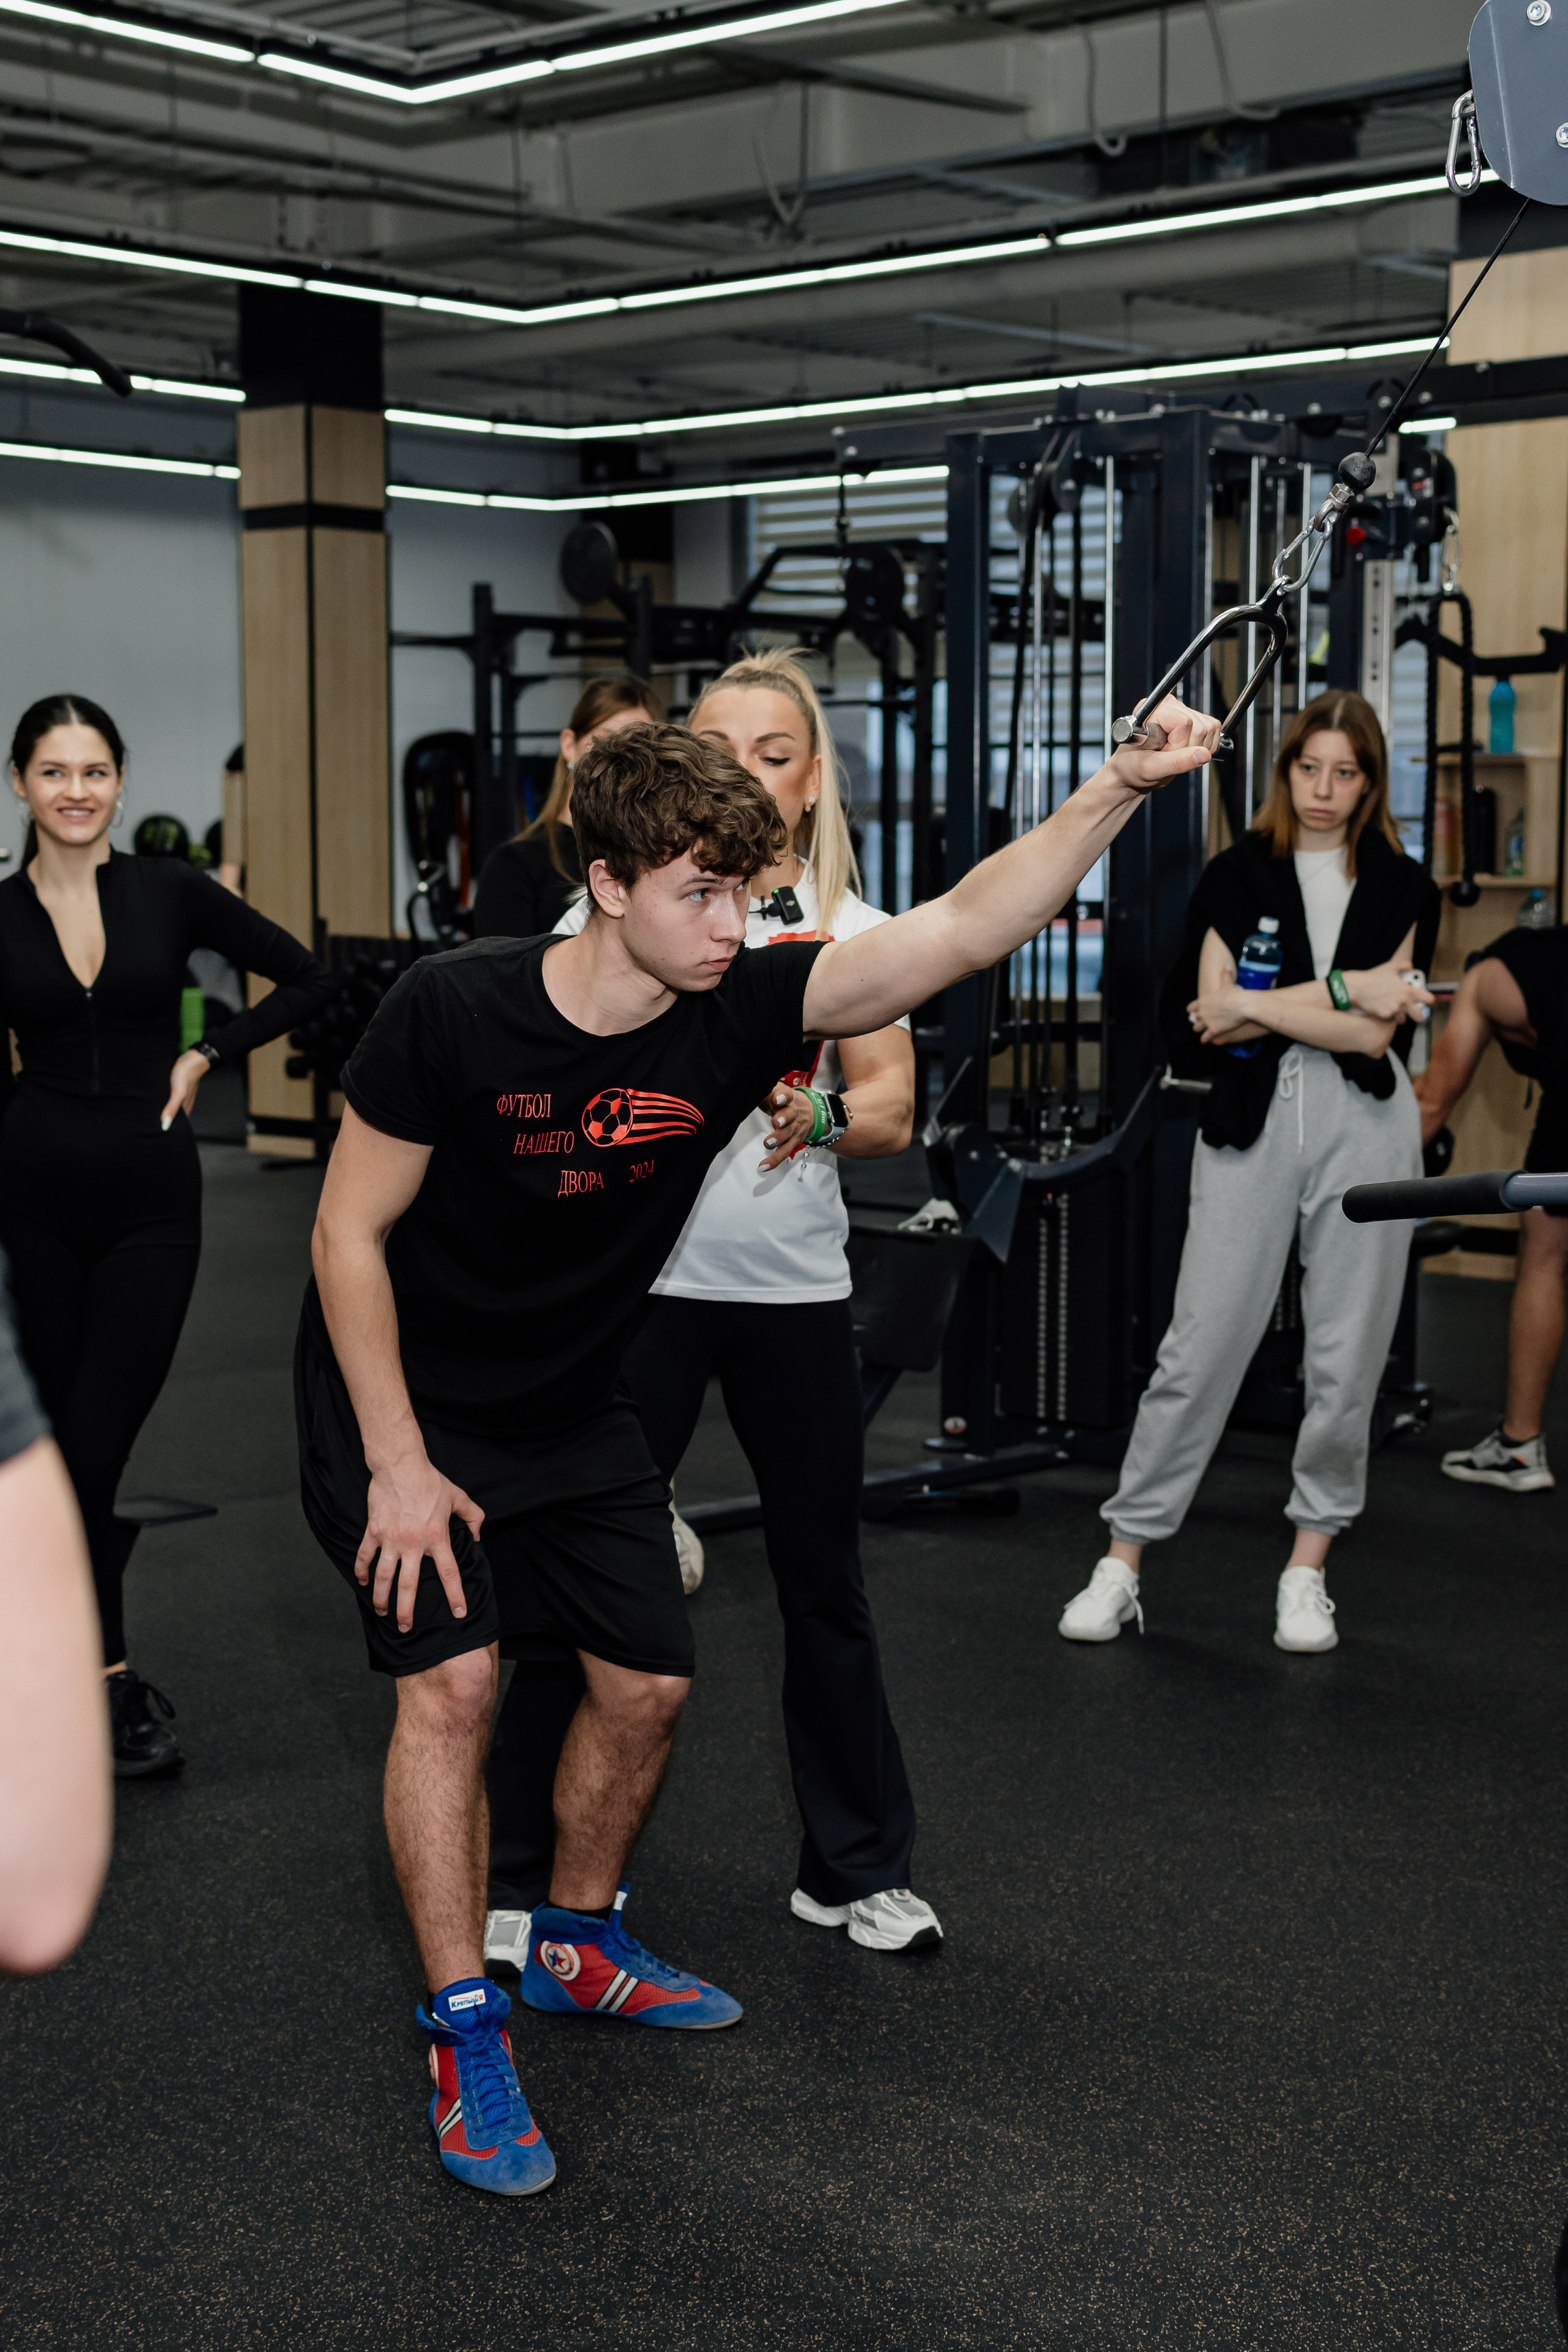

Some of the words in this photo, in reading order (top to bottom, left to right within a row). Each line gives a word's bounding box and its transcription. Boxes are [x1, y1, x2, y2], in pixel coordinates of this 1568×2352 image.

[497, 1094, 551, 1118] ФУТБОЛ
[513, 1131, 575, 1154] НАШЕГО
[558, 1170, 604, 1198] ДВОРА
[629, 1159, 654, 1182] 2024
